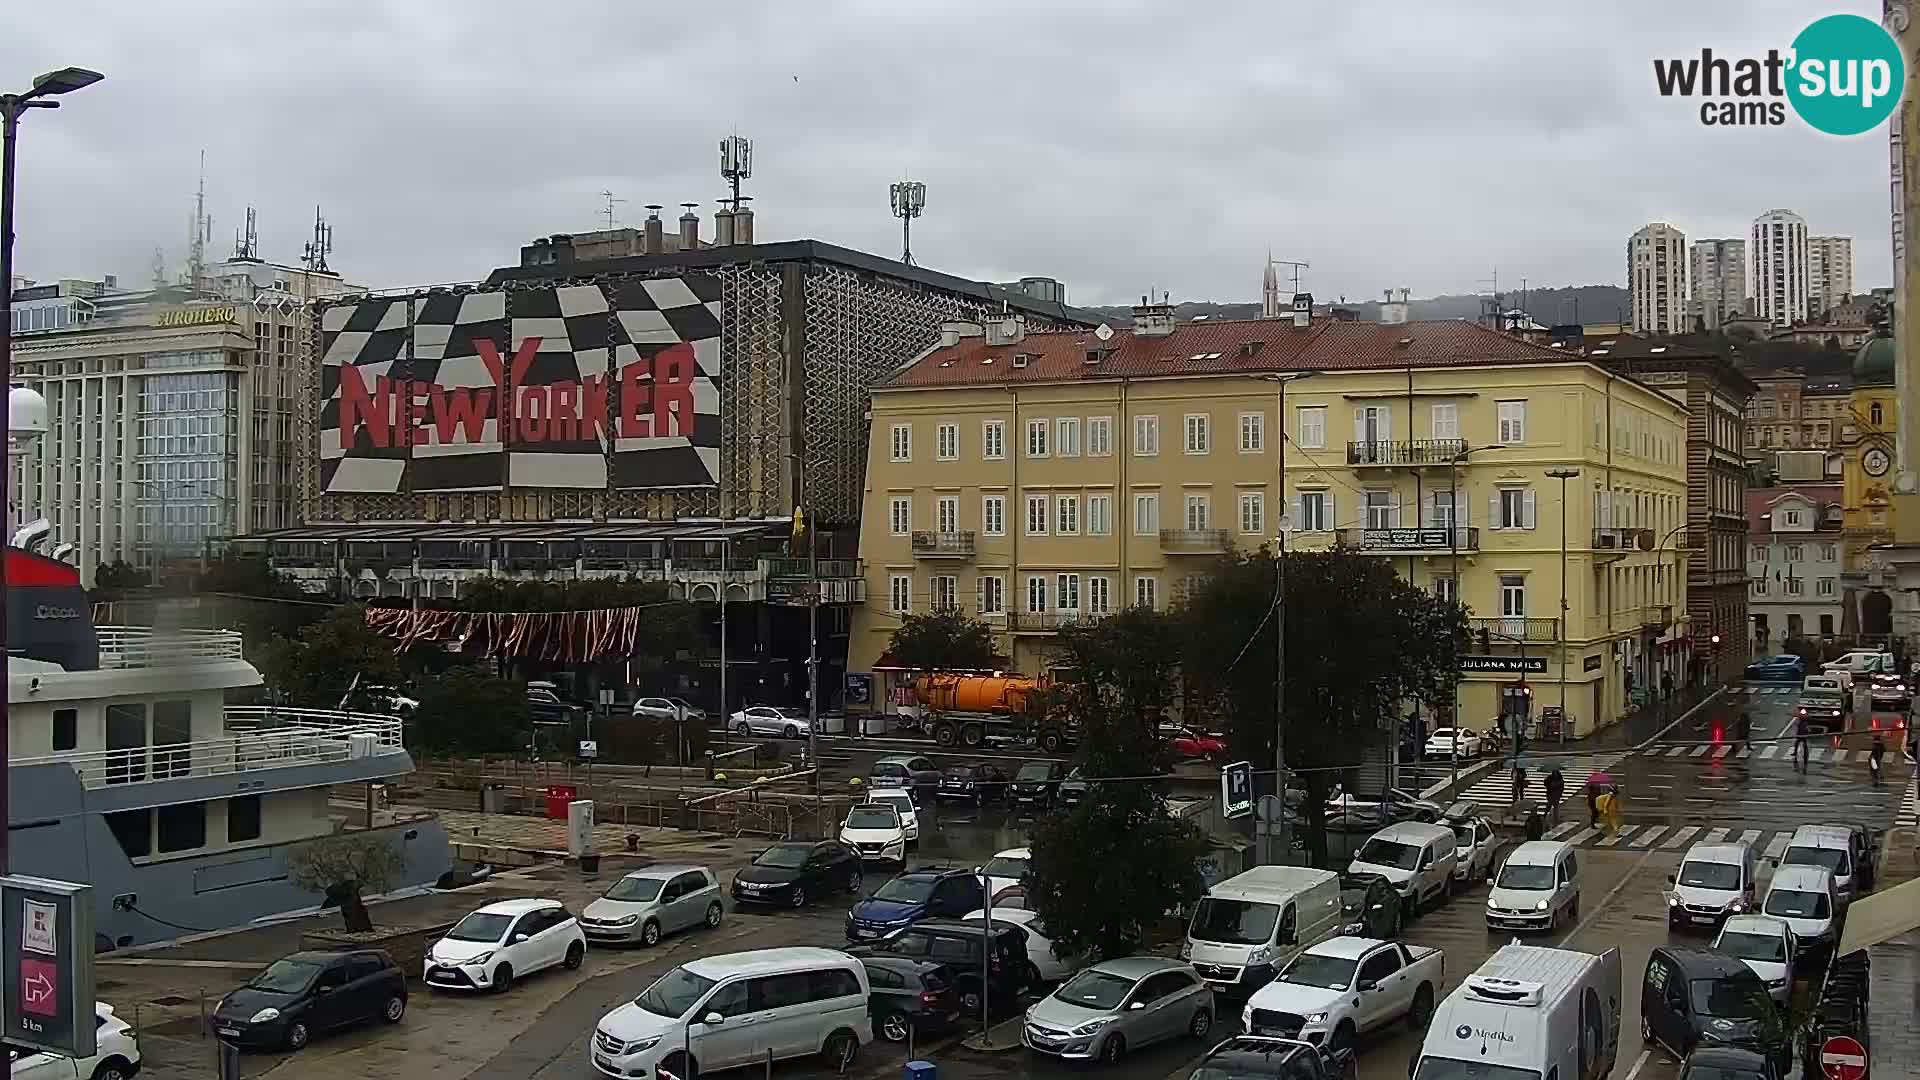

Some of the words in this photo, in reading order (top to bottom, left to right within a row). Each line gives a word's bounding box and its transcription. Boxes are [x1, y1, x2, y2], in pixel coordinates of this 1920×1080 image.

[1460, 660, 1506, 669] JULIANA
[1510, 661, 1542, 670] NAILS
[29, 1018, 43, 1033] km
